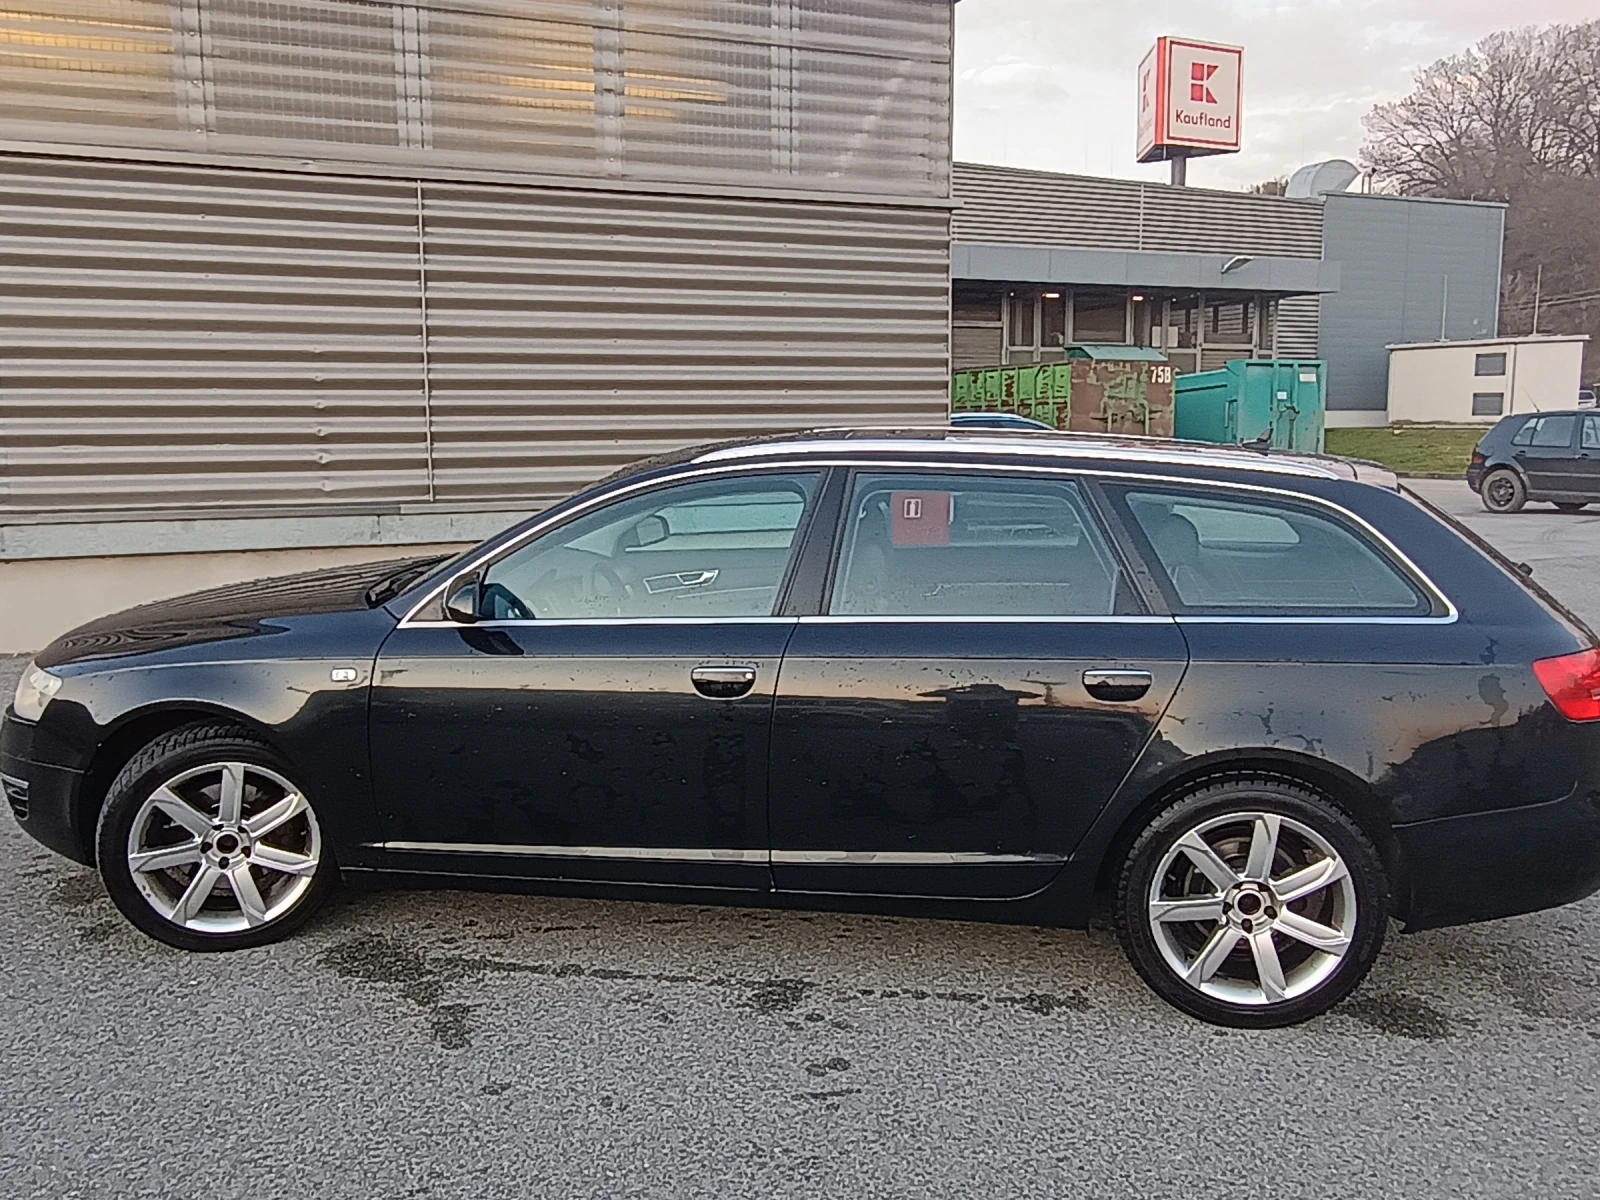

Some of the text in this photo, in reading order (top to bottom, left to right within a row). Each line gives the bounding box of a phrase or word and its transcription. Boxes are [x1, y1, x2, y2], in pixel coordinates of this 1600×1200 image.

[1190, 63, 1219, 104] K
[1175, 109, 1231, 128] Kaufland
[1150, 366, 1171, 384] 75B
